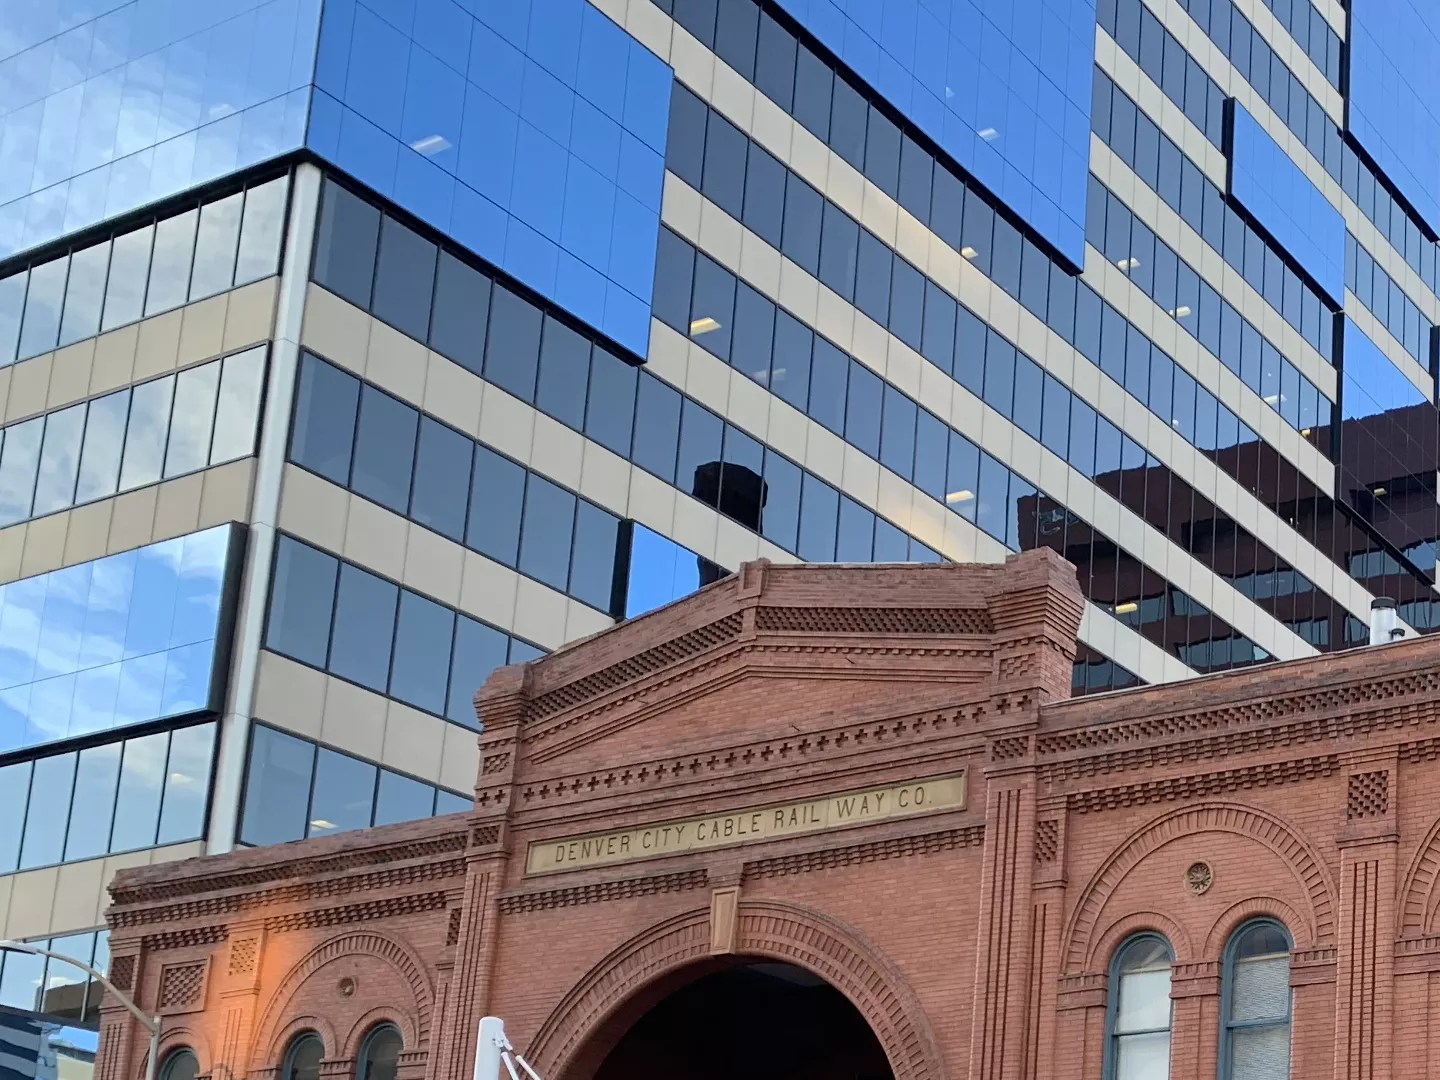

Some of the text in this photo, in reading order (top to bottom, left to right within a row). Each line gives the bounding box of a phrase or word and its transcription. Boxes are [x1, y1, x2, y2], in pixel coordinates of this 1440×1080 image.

[555, 835, 630, 863] DENVER
[643, 826, 685, 848] CITY
[697, 814, 762, 841] CABLE
